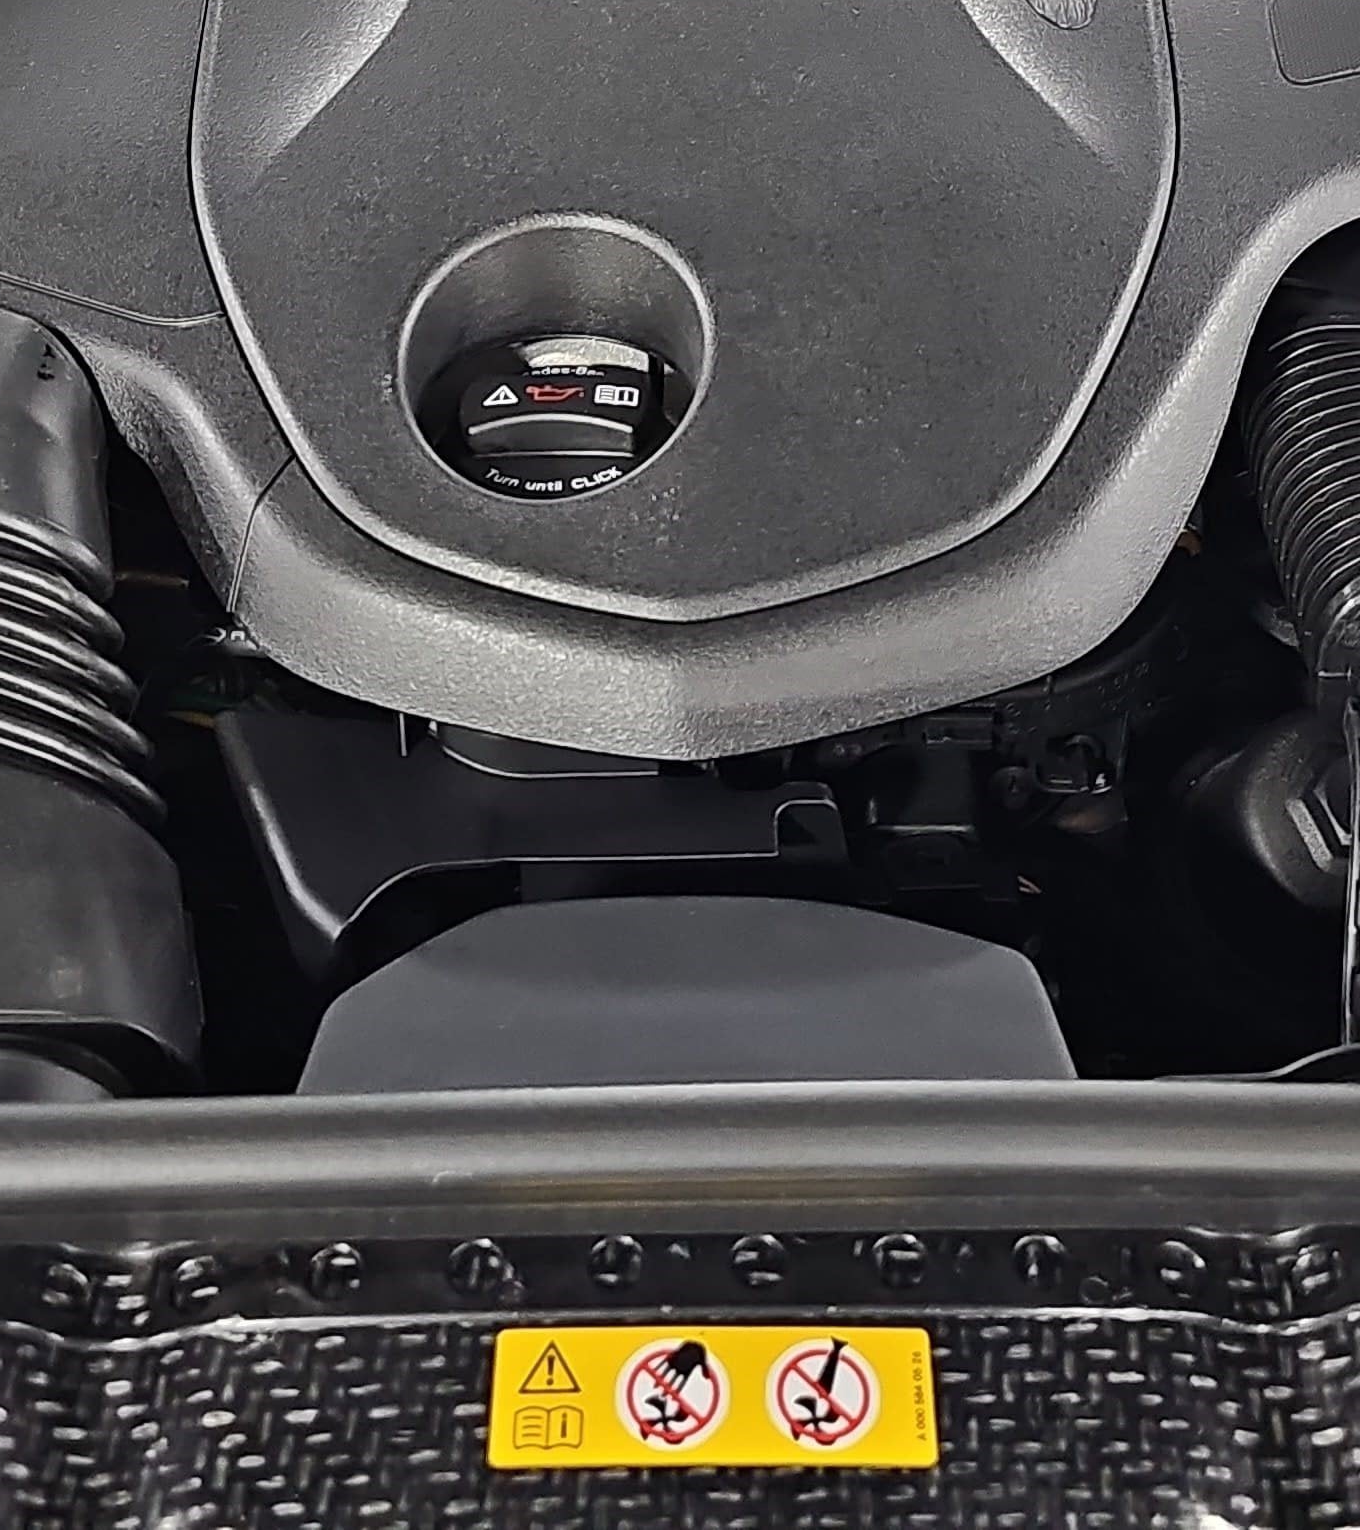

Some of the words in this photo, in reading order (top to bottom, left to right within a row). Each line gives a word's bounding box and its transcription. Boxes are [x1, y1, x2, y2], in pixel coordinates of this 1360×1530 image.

[485, 468, 520, 487] Turn
[524, 480, 563, 492] until
[570, 465, 623, 490] CLICK
